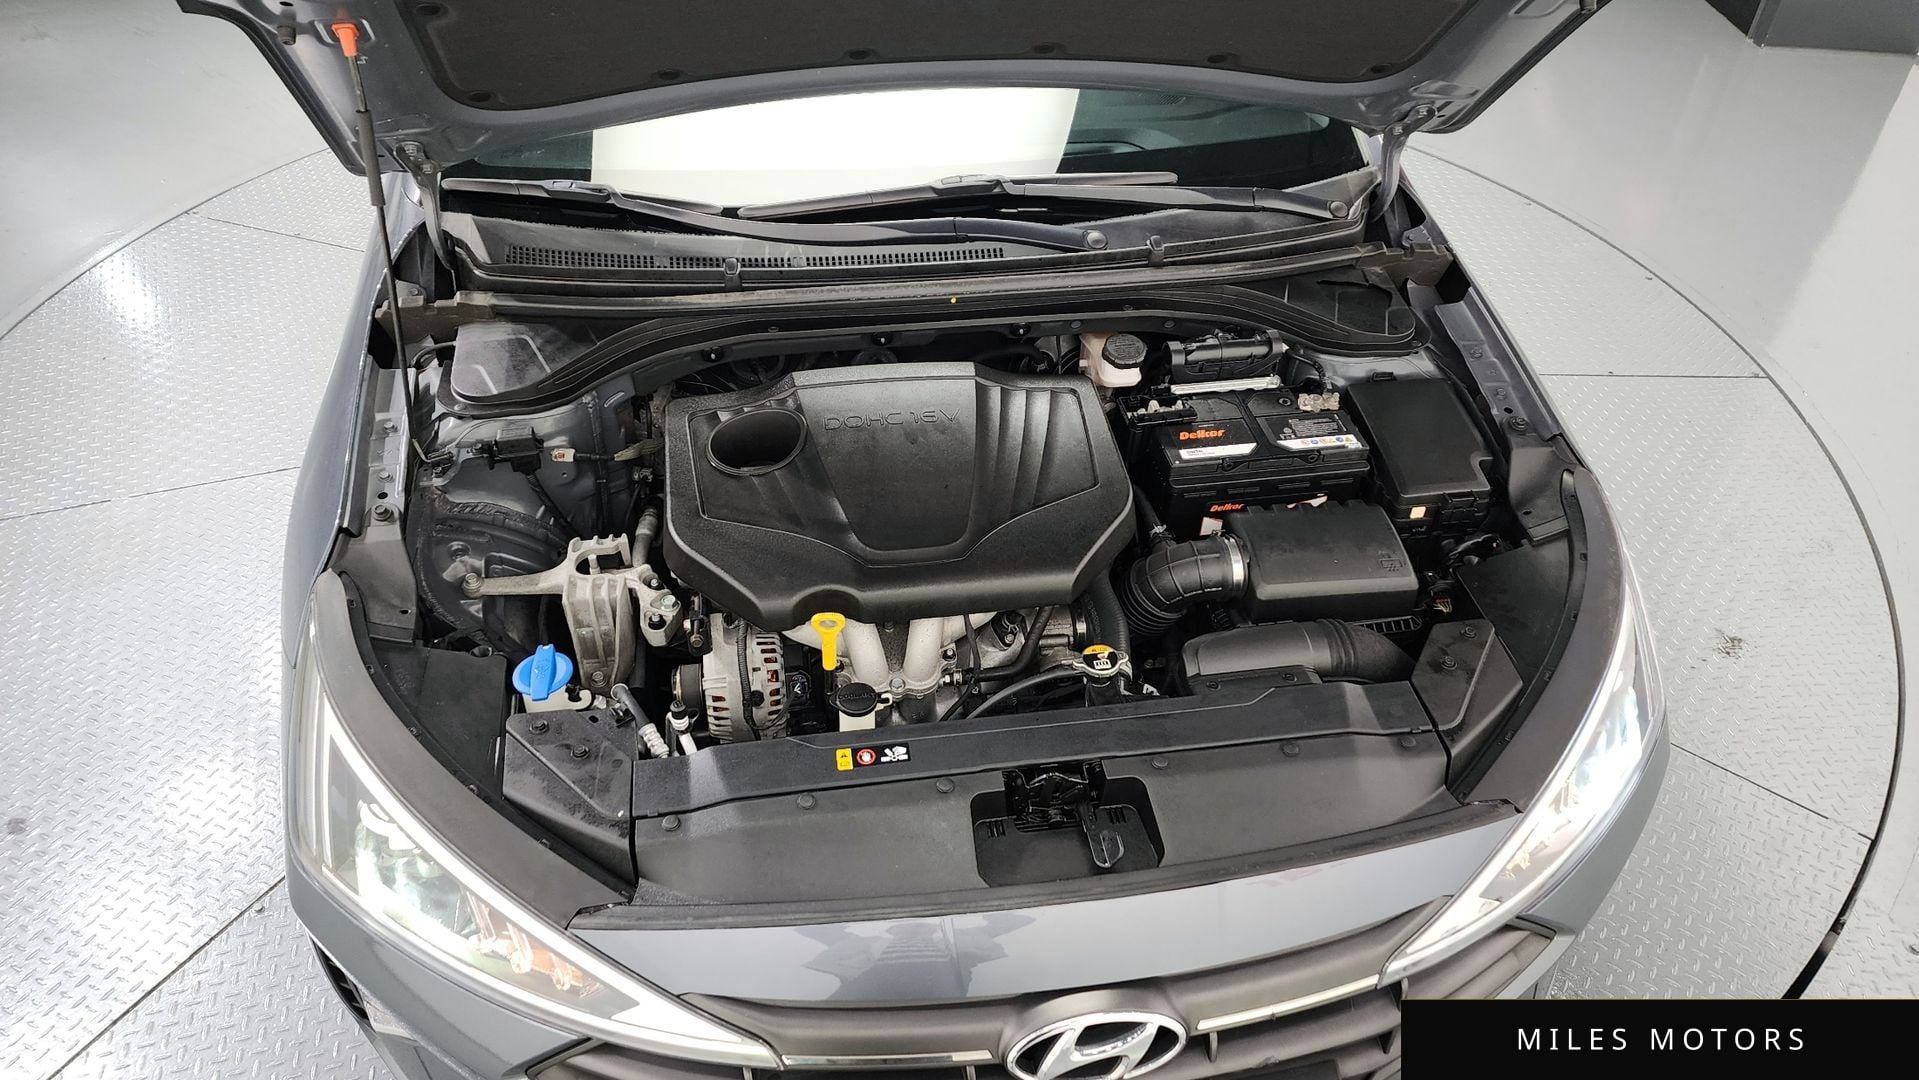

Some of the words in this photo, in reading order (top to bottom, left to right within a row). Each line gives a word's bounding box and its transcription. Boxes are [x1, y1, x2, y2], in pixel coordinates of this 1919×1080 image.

[823, 412, 904, 431] DOHC
[909, 408, 960, 424] 16V
[1179, 429, 1225, 441] Delkor
[1209, 503, 1245, 512] Delkor
